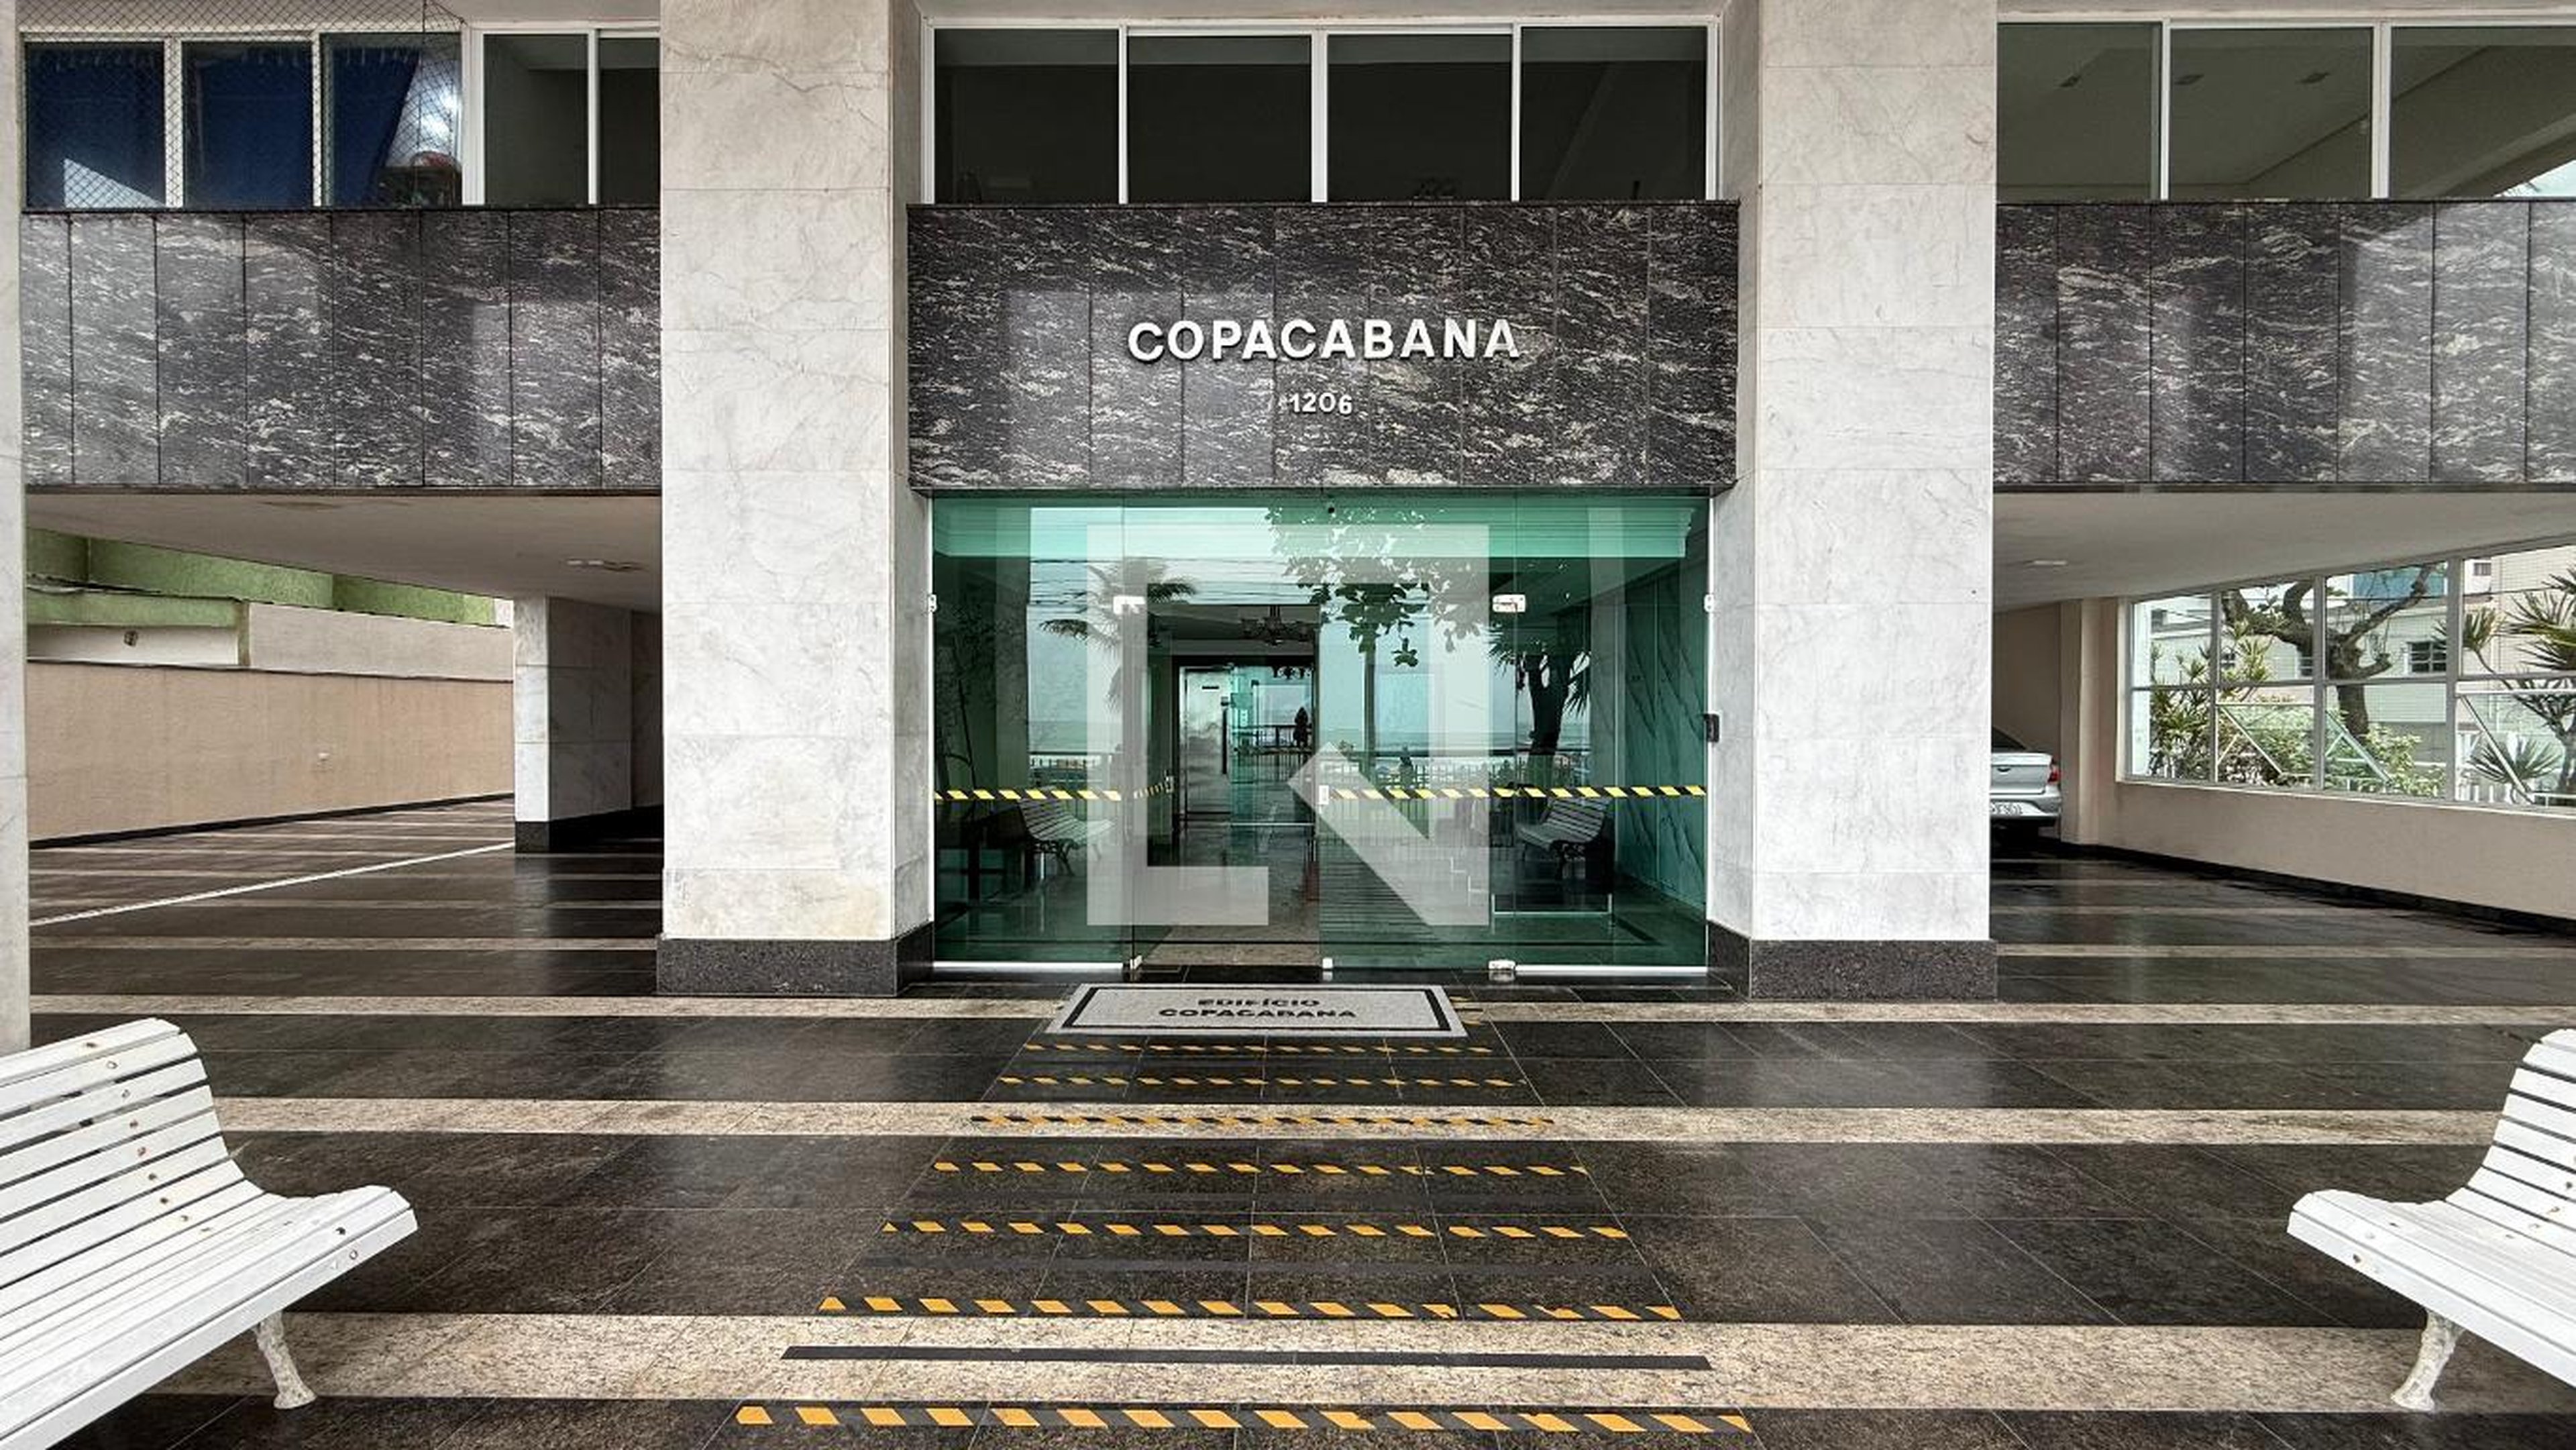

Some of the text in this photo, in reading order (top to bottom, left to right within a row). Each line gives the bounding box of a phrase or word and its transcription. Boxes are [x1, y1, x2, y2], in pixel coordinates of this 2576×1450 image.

[1127, 318, 1520, 362] COPACABANA
[1288, 392, 1353, 415] 1206
[1197, 998, 1320, 1007] EDIFÍCIO
[1159, 1008, 1356, 1018] COPACABANA
